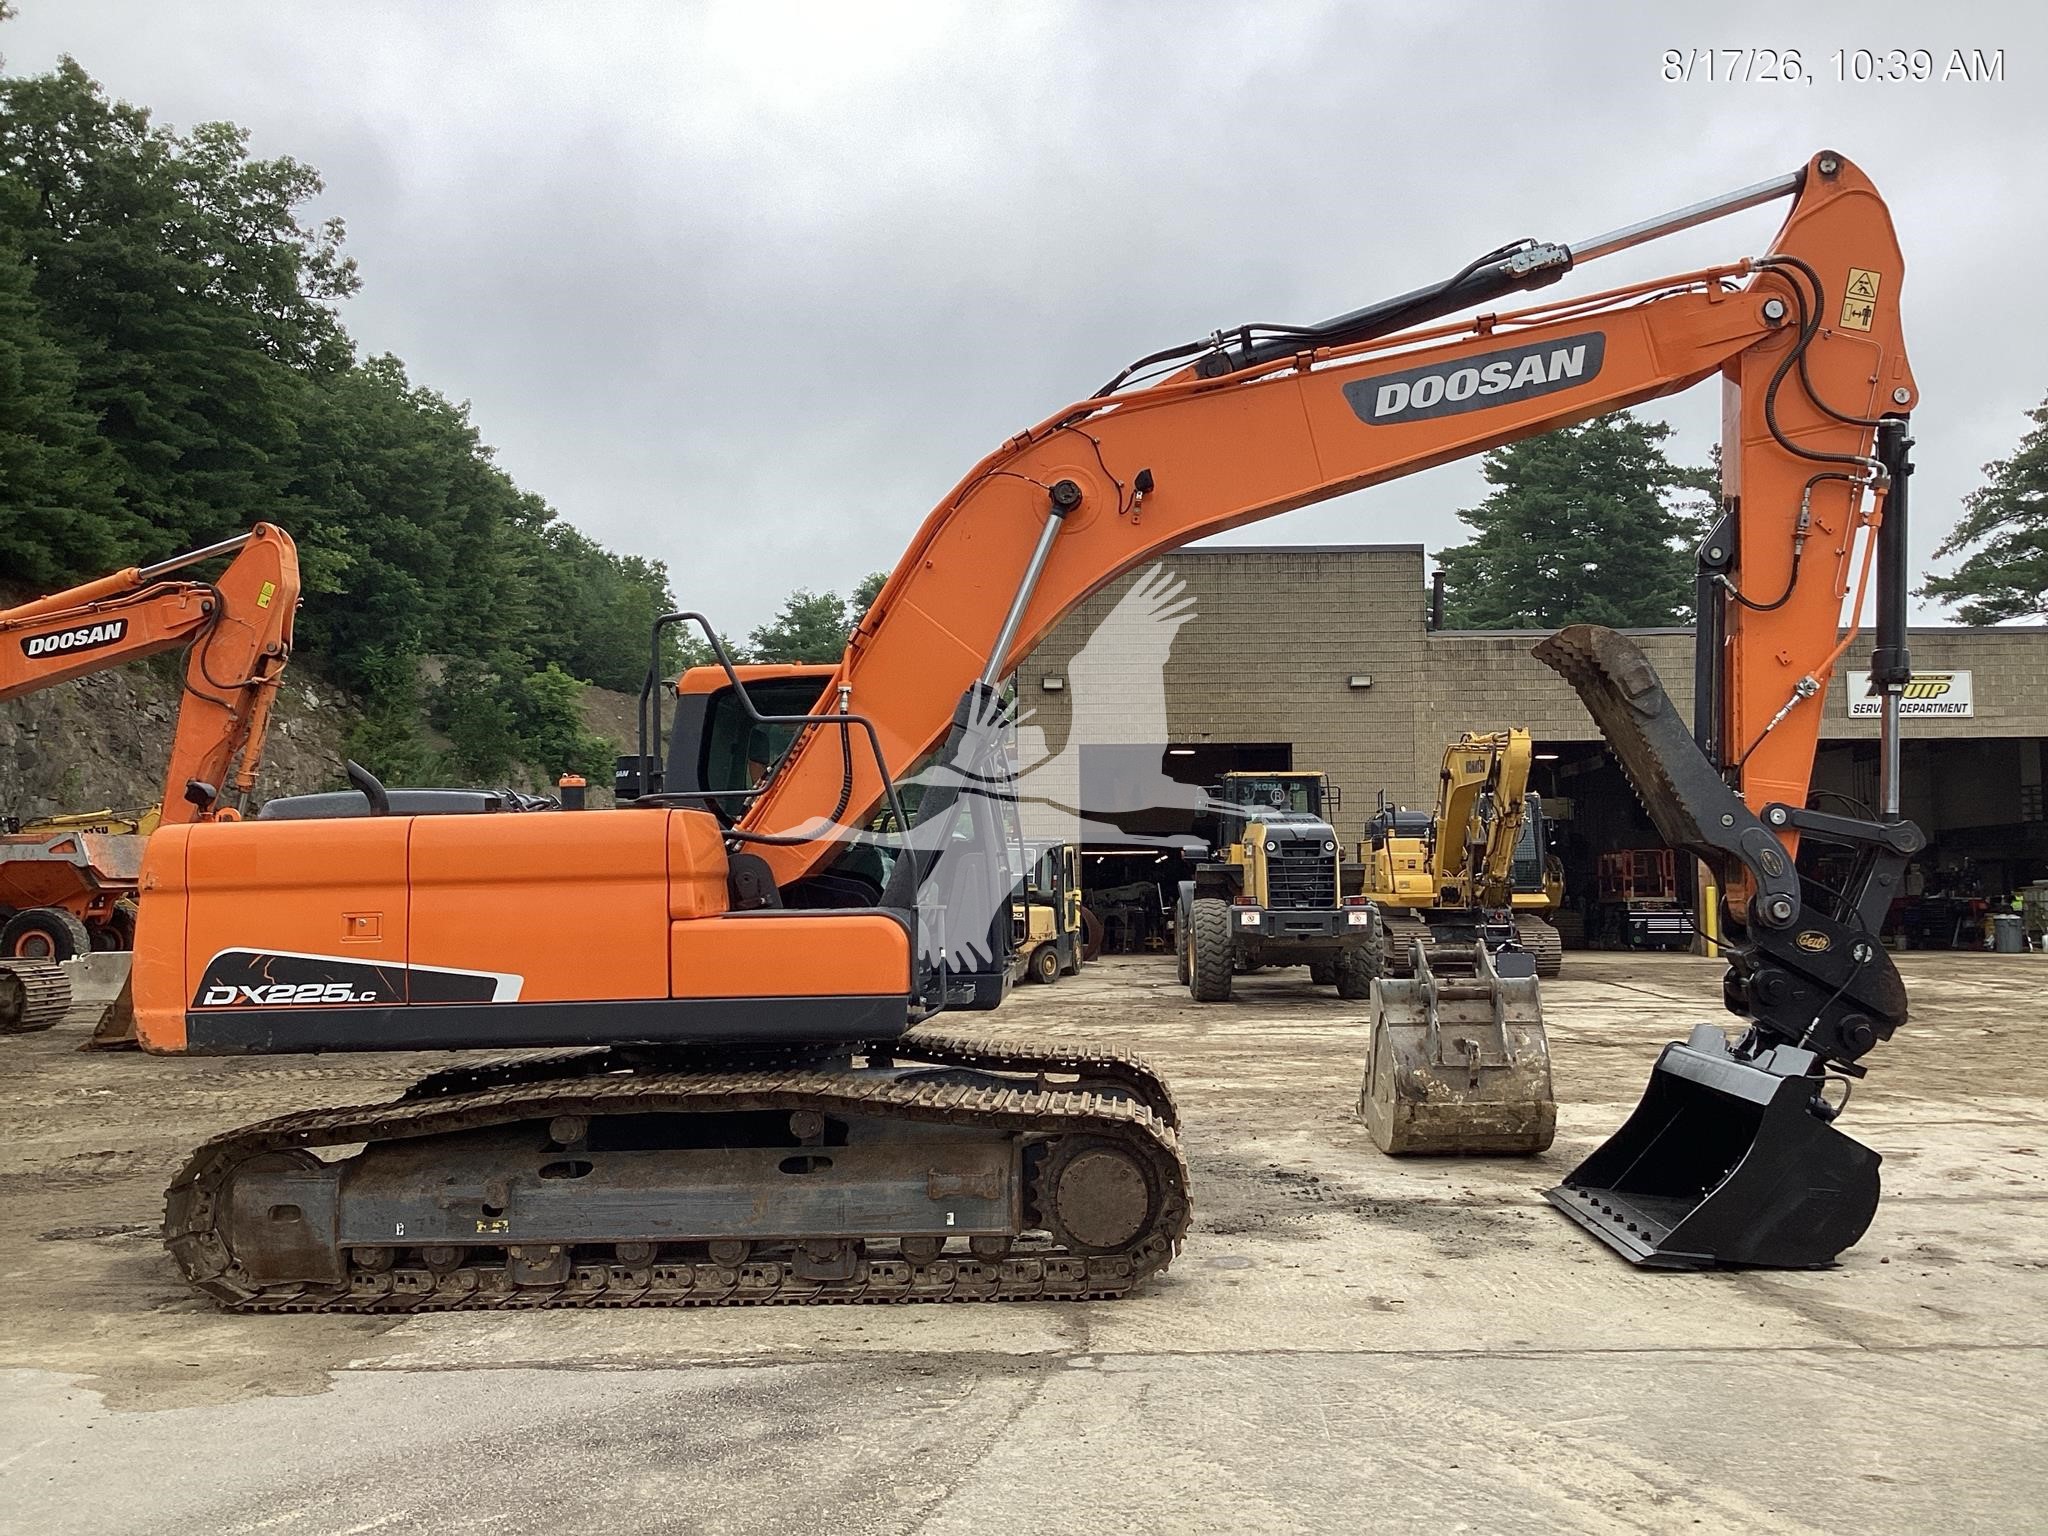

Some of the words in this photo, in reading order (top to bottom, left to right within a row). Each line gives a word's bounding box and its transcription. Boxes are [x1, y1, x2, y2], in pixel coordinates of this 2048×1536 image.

[1374, 344, 1586, 417] DOOSAN
[27, 622, 122, 656] DOOSAN
[1853, 703, 1882, 714] SERV
[1898, 703, 1968, 713] DEPARTMENT
